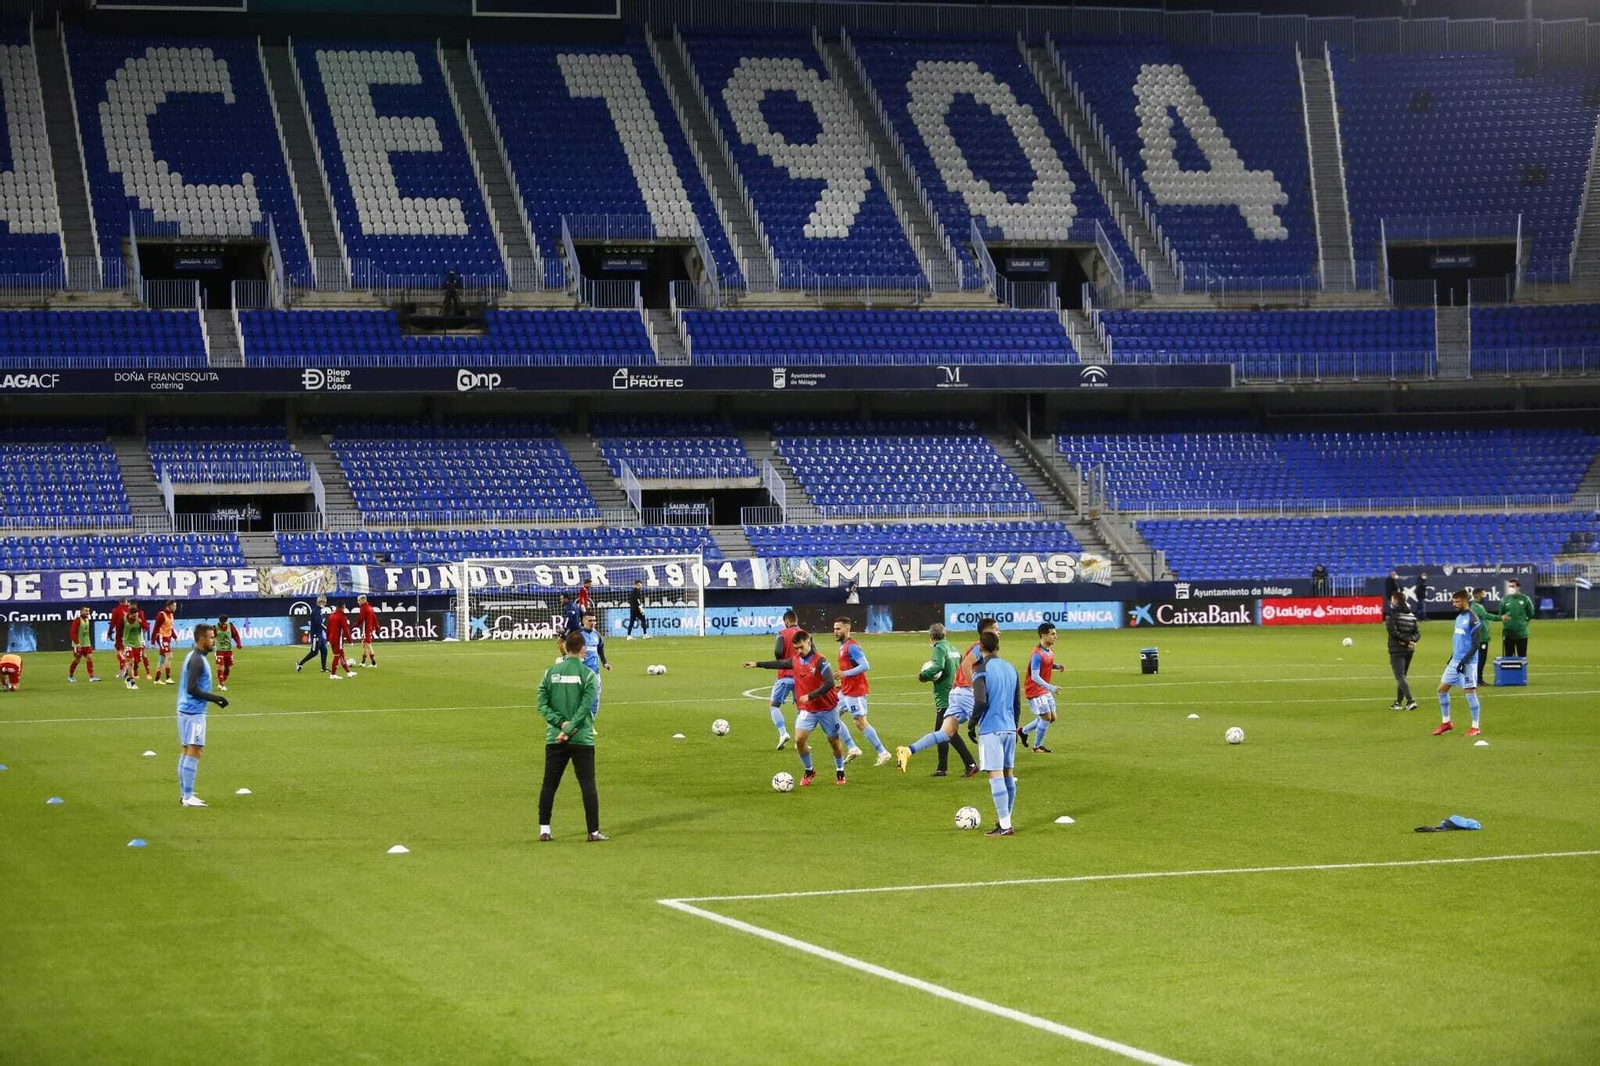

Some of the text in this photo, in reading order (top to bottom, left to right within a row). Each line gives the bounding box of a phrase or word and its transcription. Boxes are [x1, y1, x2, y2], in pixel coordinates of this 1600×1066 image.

[114, 371, 219, 382] DOÑA FRANCISQUITA
[150, 382, 184, 390] catering
[327, 382, 352, 390] López
[629, 379, 684, 388] PROTEC
[384, 560, 738, 591] FONDO SUR 1904
[827, 554, 1076, 587] MALAKAS
[59, 568, 259, 600] SIEMPRE
[1193, 586, 1293, 598] Ayuntamiento de Málaga
[8, 610, 61, 622] Garum
[1156, 604, 1251, 625] CaixaBank
[1276, 604, 1383, 619] LaLiga SmartBank
